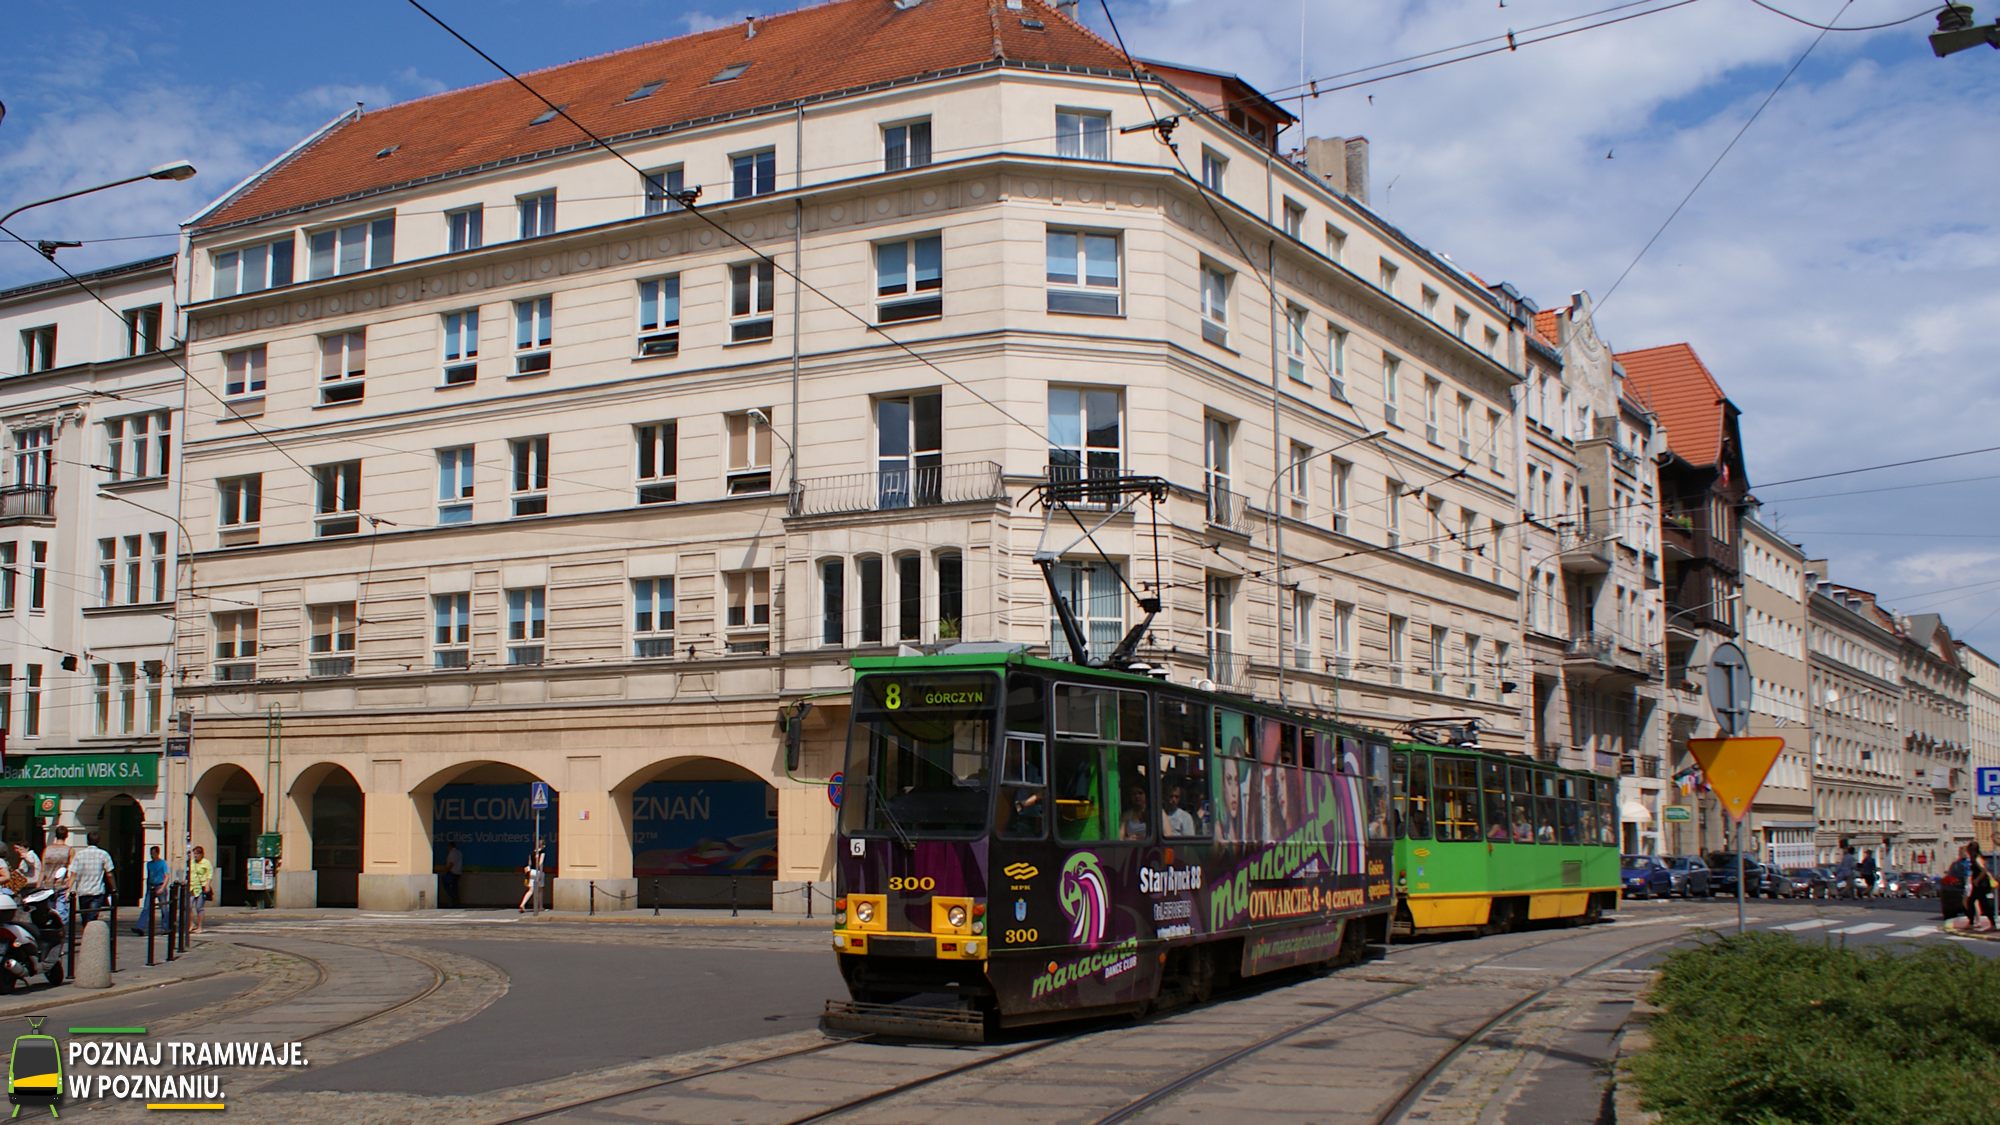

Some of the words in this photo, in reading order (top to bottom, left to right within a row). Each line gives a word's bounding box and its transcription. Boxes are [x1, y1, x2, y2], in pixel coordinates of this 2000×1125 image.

[885, 683, 901, 710] 8
[925, 691, 983, 704] GÓRCZYN
[4, 765, 31, 779] Bank
[33, 763, 85, 779] Zachodni
[86, 762, 117, 778] WBK
[119, 762, 144, 778] S.A.
[1984, 769, 2000, 793] P
[633, 789, 711, 820] ZNAŃ
[447, 831, 473, 843] Cities
[475, 831, 530, 843] Volunteers
[853, 841, 861, 854] 6
[888, 876, 936, 891] 300
[1140, 866, 1168, 896] Stary
[1191, 865, 1202, 889] 88
[1250, 890, 1312, 920] OTWARCIE:
[1312, 885, 1320, 912] 8
[1325, 892, 1332, 914] 9
[1333, 887, 1365, 909] czerwca
[1005, 928, 1039, 944] 300
[1030, 935, 1138, 998] maracana
[1105, 961, 1123, 979] DANCE
[1123, 956, 1137, 972] CLUB
